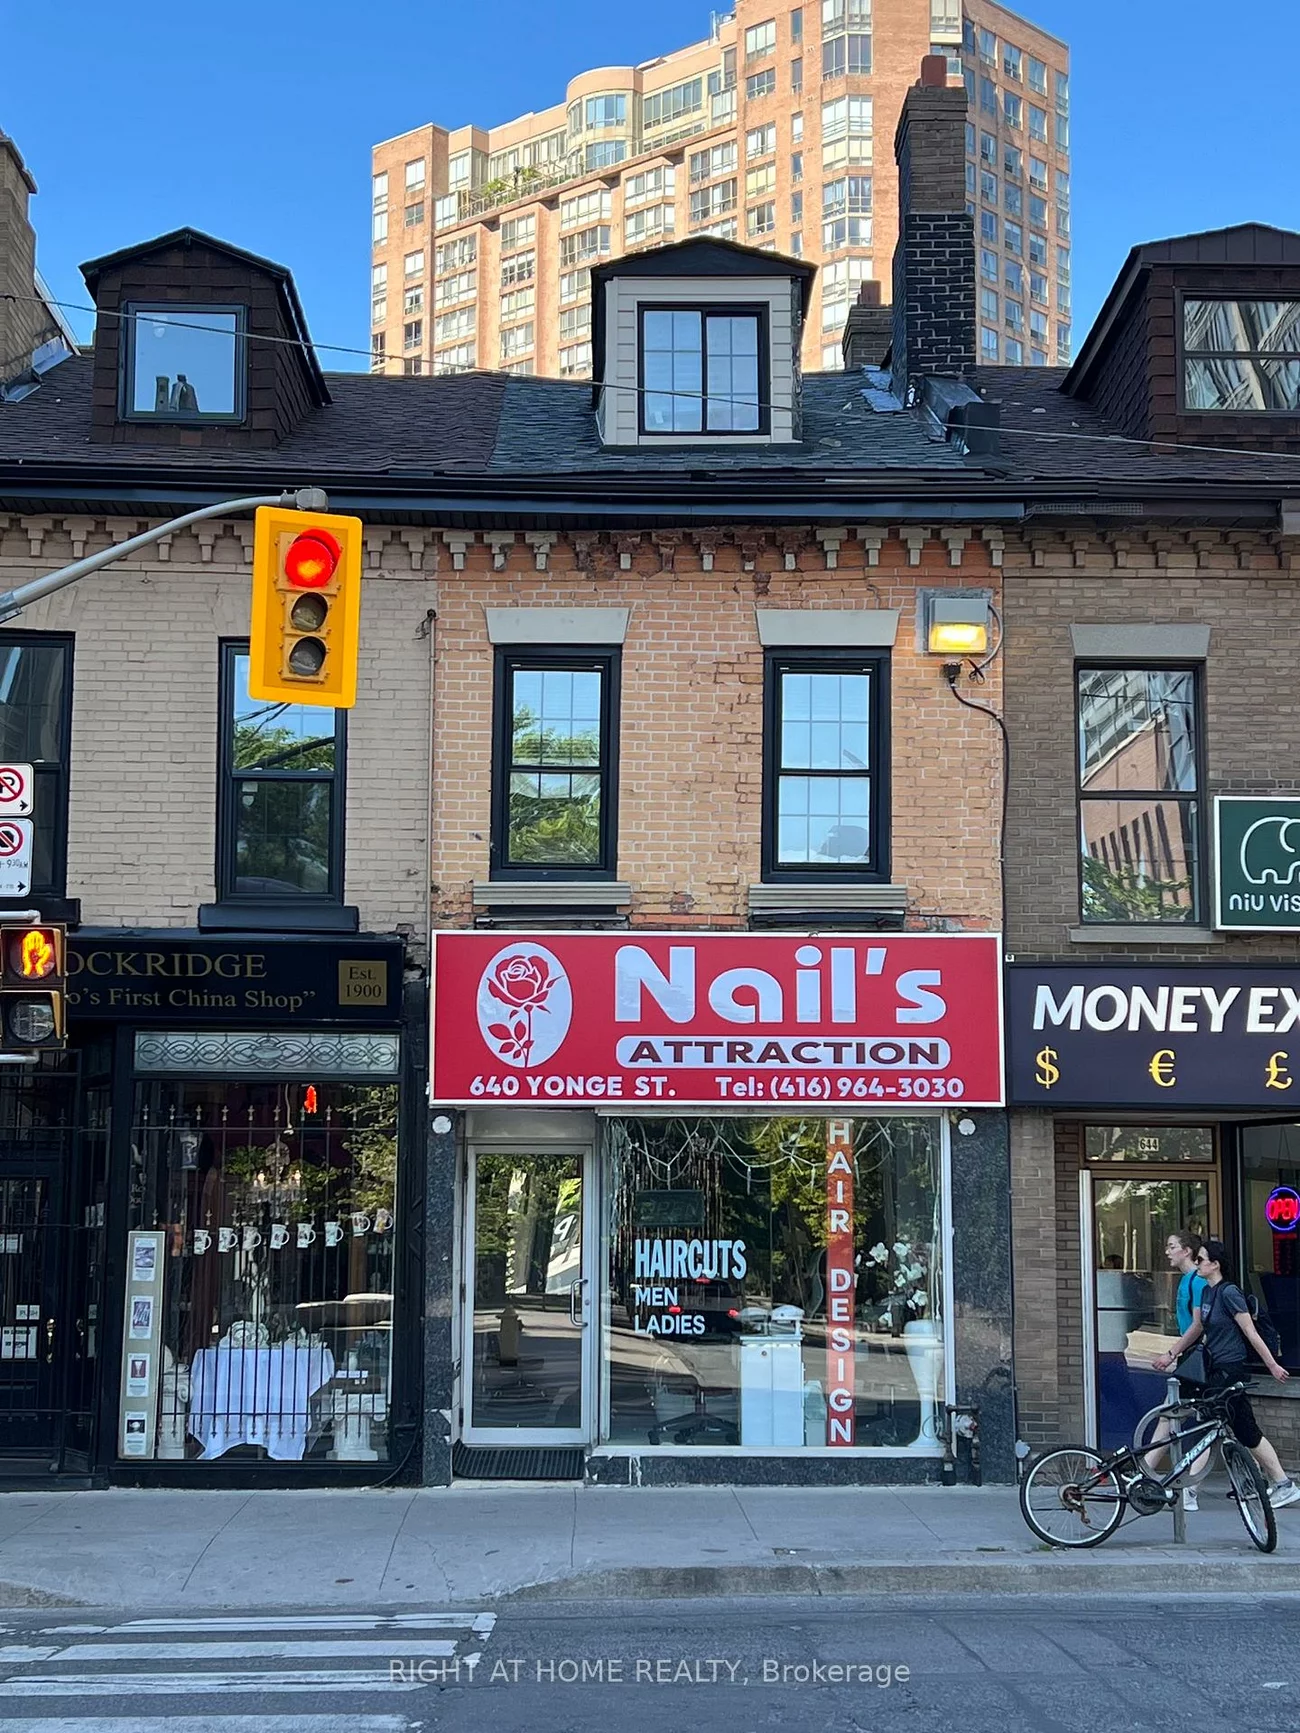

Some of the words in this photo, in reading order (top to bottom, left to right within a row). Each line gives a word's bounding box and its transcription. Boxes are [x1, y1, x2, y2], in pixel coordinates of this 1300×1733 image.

[1229, 893, 1264, 911] niu
[345, 983, 382, 999] 1900
[614, 945, 946, 1024] Nail's
[108, 988, 161, 1007] First
[169, 989, 236, 1008] China
[1033, 984, 1241, 1033] MONEY
[628, 1040, 941, 1065] ATTRACTION
[469, 1076, 520, 1098] 640
[526, 1076, 623, 1098] YONGE
[633, 1076, 676, 1098] ST.
[715, 1076, 764, 1098] Tel:
[770, 1075, 831, 1100] (416)
[836, 1076, 965, 1099] 964-3030
[1140, 1138, 1157, 1150] 644
[829, 1121, 851, 1233] HAIR
[1269, 1198, 1299, 1220] OPEN
[635, 1239, 747, 1279] HAIRCUTS
[635, 1287, 678, 1306] MEN
[634, 1314, 706, 1334] LADIES
[829, 1268, 852, 1443] DESIGN
